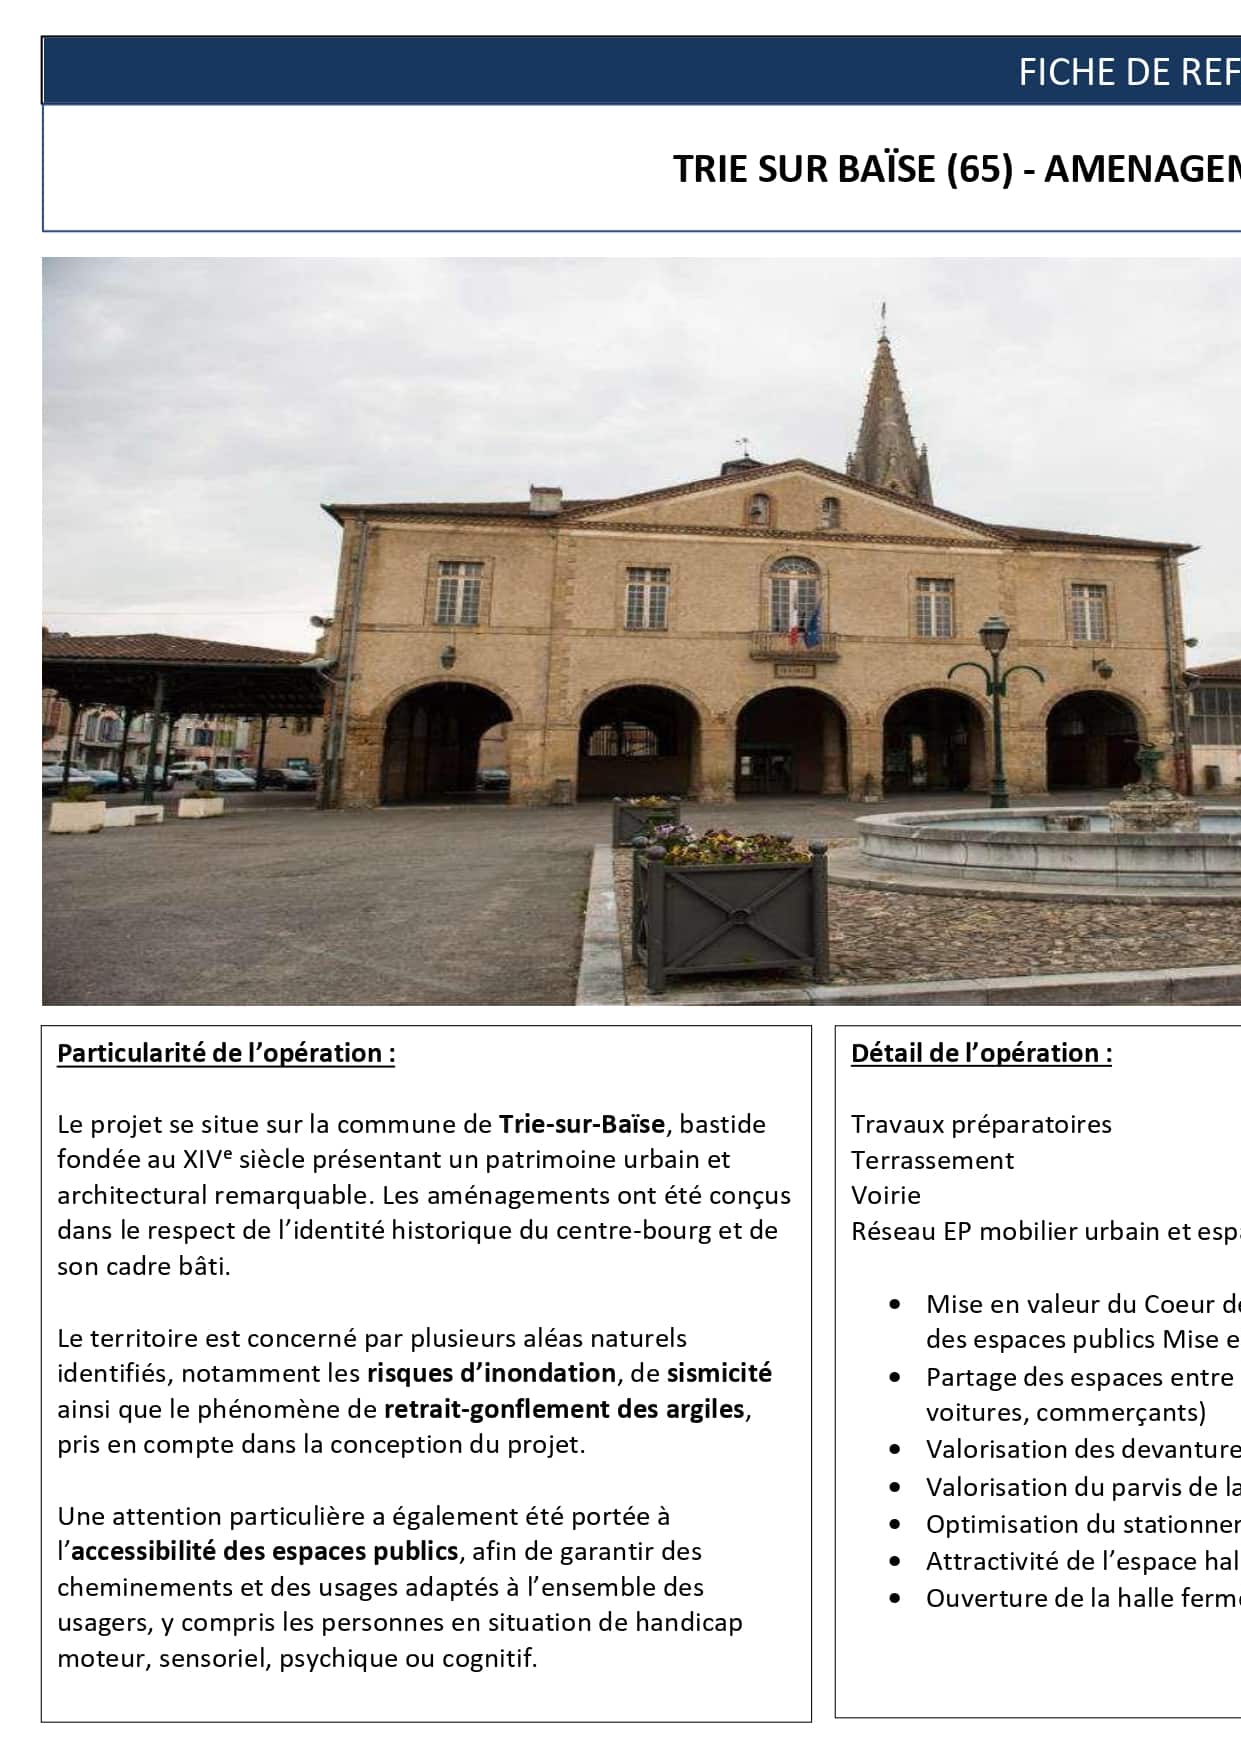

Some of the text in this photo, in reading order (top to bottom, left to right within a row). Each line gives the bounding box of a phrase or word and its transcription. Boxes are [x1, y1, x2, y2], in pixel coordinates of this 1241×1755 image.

[1020, 57, 1115, 86] FICHE
[1127, 57, 1170, 86] DE
[672, 154, 748, 183] TRIE
[758, 154, 829, 183] SUR
[839, 147, 936, 183] BAÏSE
[947, 152, 1013, 190] (65)
[57, 1040, 206, 1067] Particularité
[212, 1041, 242, 1063] de
[249, 1040, 382, 1066] l’opération
[852, 1040, 923, 1063] Détail
[929, 1041, 959, 1063] de
[966, 1040, 1099, 1066] l’opération
[58, 1112, 766, 1139] Le projet se situe sur la commune de Trie-sur-Baïse, bastide
[850, 1113, 1112, 1139] Travaux préparatoires
[56, 1147, 141, 1169] fondée
[147, 1154, 175, 1169] au
[239, 1147, 305, 1169] siècle
[313, 1148, 442, 1174] présentant
[449, 1154, 478, 1169] un
[486, 1149, 616, 1174] patrimoine
[624, 1147, 699, 1169] urbain
[707, 1151, 731, 1169] et
[850, 1150, 1015, 1170] Terrassement
[57, 1183, 791, 1210] architectural remarquable. Les aménagements ont été conçus
[851, 1185, 921, 1205] Voirie
[852, 1220, 935, 1241] Réseau
[944, 1221, 972, 1241] EP
[980, 1219, 1079, 1241] mobilier
[1085, 1219, 1159, 1241] urbain
[1167, 1223, 1192, 1241] et
[58, 1360, 773, 1388] identifiés, notamment les risques d’inondation, de sismicité
[927, 1367, 1017, 1392] Partage
[1023, 1365, 1064, 1387] des
[1070, 1372, 1163, 1392] espaces
[1170, 1369, 1234, 1387] entre
[57, 1397, 751, 1424] ainsi que le phénomène de retrait-gonflement des argiles,
[926, 1400, 1206, 1427] voitures, commerçants)
[926, 1437, 1067, 1459] Valorisation
[1074, 1437, 1115, 1459] des
[926, 1514, 1078, 1539] Optimisation
[1086, 1512, 1115, 1534] du
[926, 1550, 1059, 1571] Attractivité
[1066, 1549, 1095, 1571] de
[1103, 1549, 1197, 1576] l’espace
